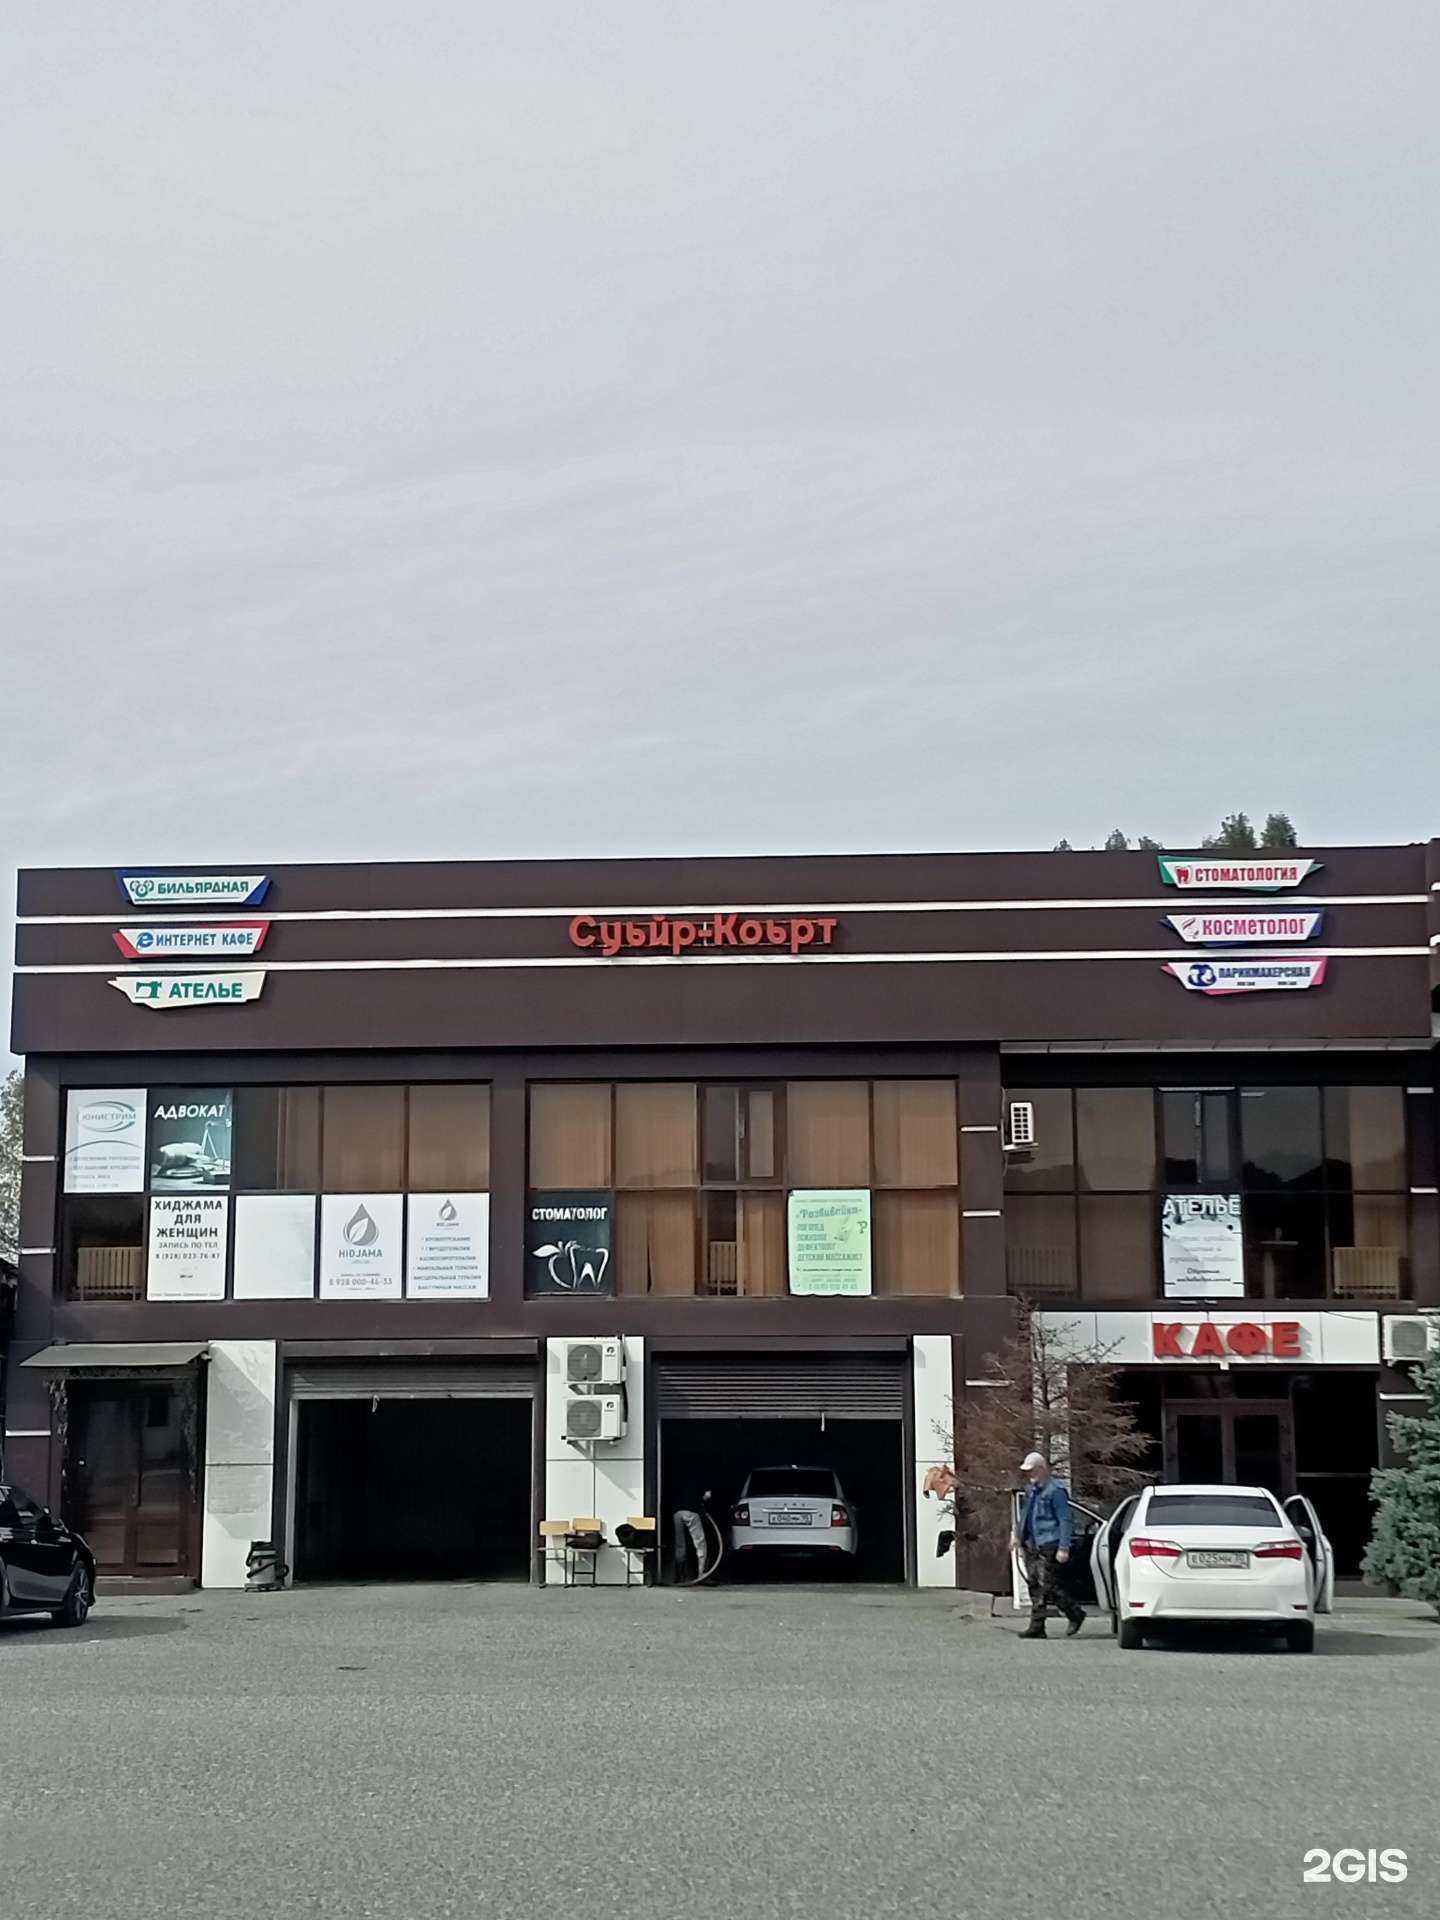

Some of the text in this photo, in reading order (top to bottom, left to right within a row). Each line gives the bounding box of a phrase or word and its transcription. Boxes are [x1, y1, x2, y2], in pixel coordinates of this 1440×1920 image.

[1195, 867, 1298, 882] СТОМАТОЛОГИЯ
[158, 881, 249, 894] БИЛЬЯРДНАЯ
[1202, 918, 1306, 936] КОСМЕТОЛОГ
[156, 932, 253, 946] ИНТЕРНЕТ КАФЕ
[569, 913, 837, 956] Суьйр-Коьрт
[1218, 966, 1311, 979] ПАРИКМАХЕРСКАЯ
[169, 982, 243, 998] АТЕЛЬЕ
[82, 1111, 136, 1122] ЮНИСТРИМ
[154, 1104, 225, 1120] АДВОКАТ
[154, 1201, 223, 1212] ХИДЖАМА
[1162, 1198, 1241, 1216] АТЕЛЬЕ
[174, 1214, 202, 1225] ДЛЯ
[532, 1207, 608, 1220] СТОМАТОЛОГ
[157, 1227, 218, 1239] ЖЕНЩИН
[205, 1241, 218, 1249] ТЕЛ
[338, 1249, 383, 1258] HIDJAMA
[1152, 1322, 1303, 1358] КАФЕ
